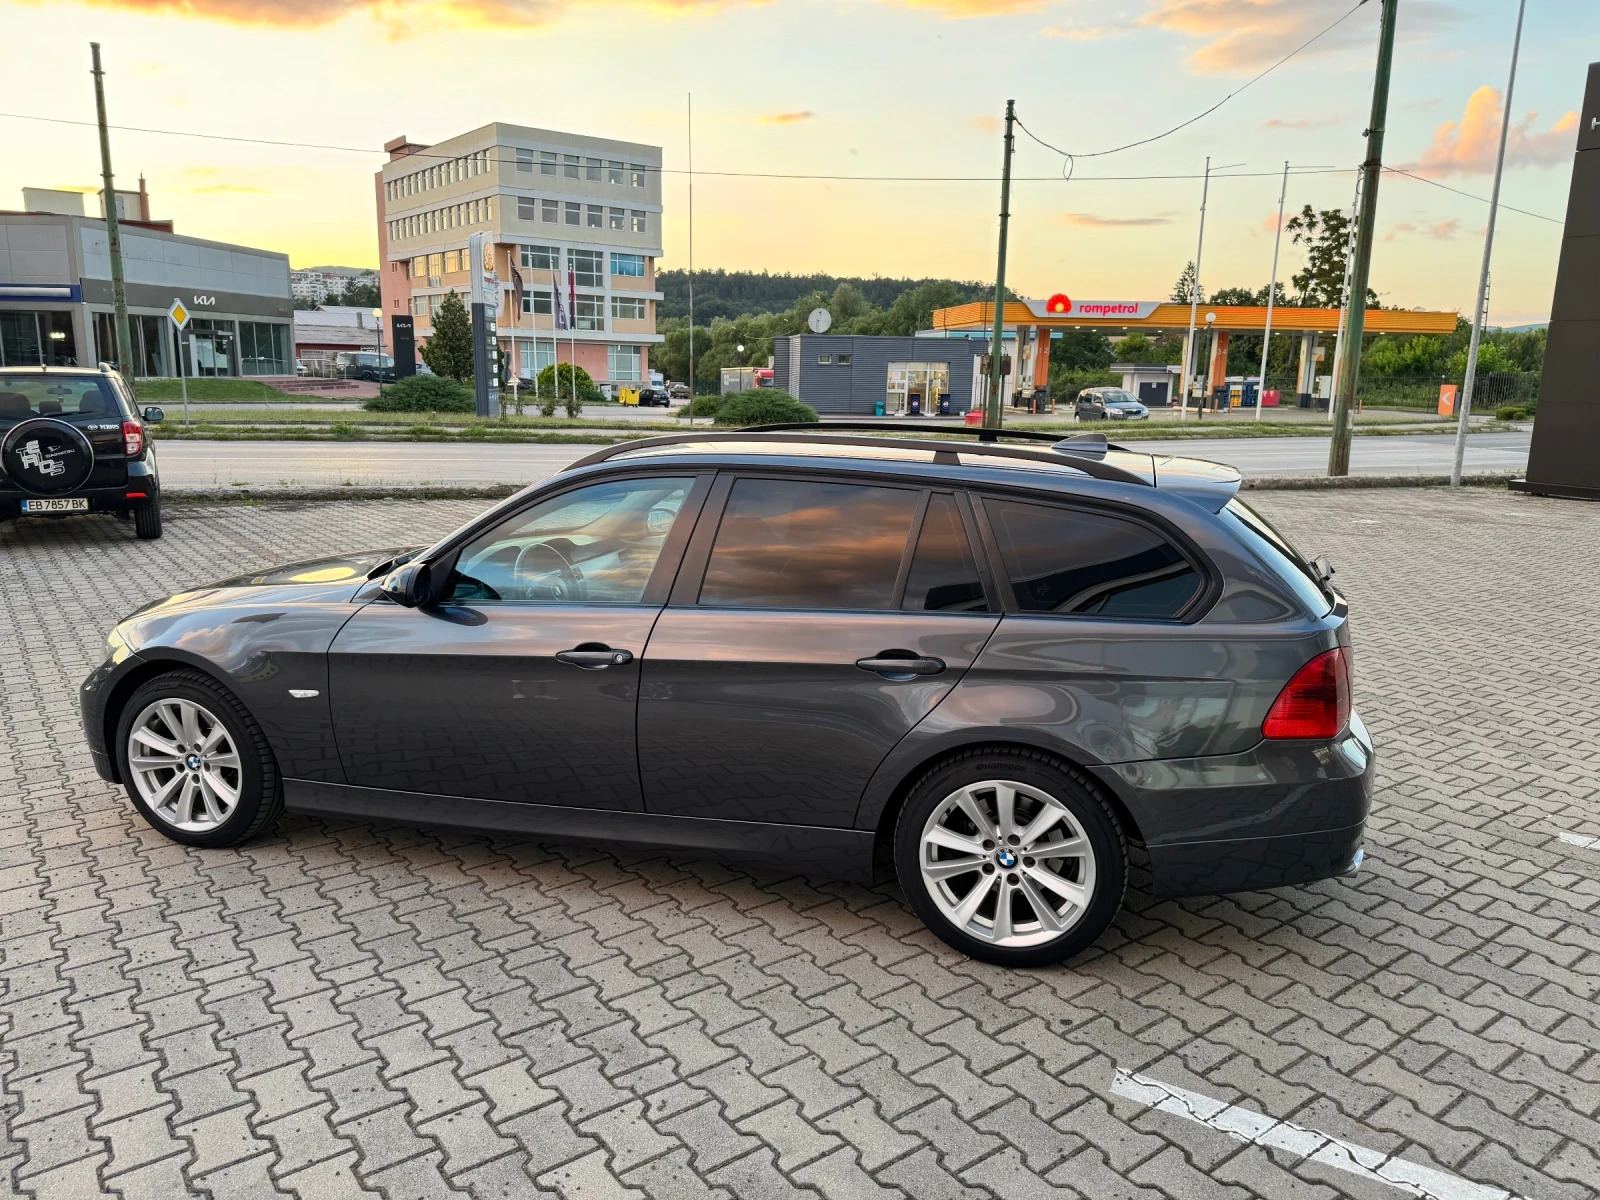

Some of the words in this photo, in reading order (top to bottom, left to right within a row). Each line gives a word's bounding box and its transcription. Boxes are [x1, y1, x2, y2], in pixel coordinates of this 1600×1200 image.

[193, 294, 216, 306] KIA
[1079, 302, 1139, 317] rompetrol
[28, 500, 43, 510] EB
[44, 499, 70, 509] 7857
[72, 499, 86, 509] BK
